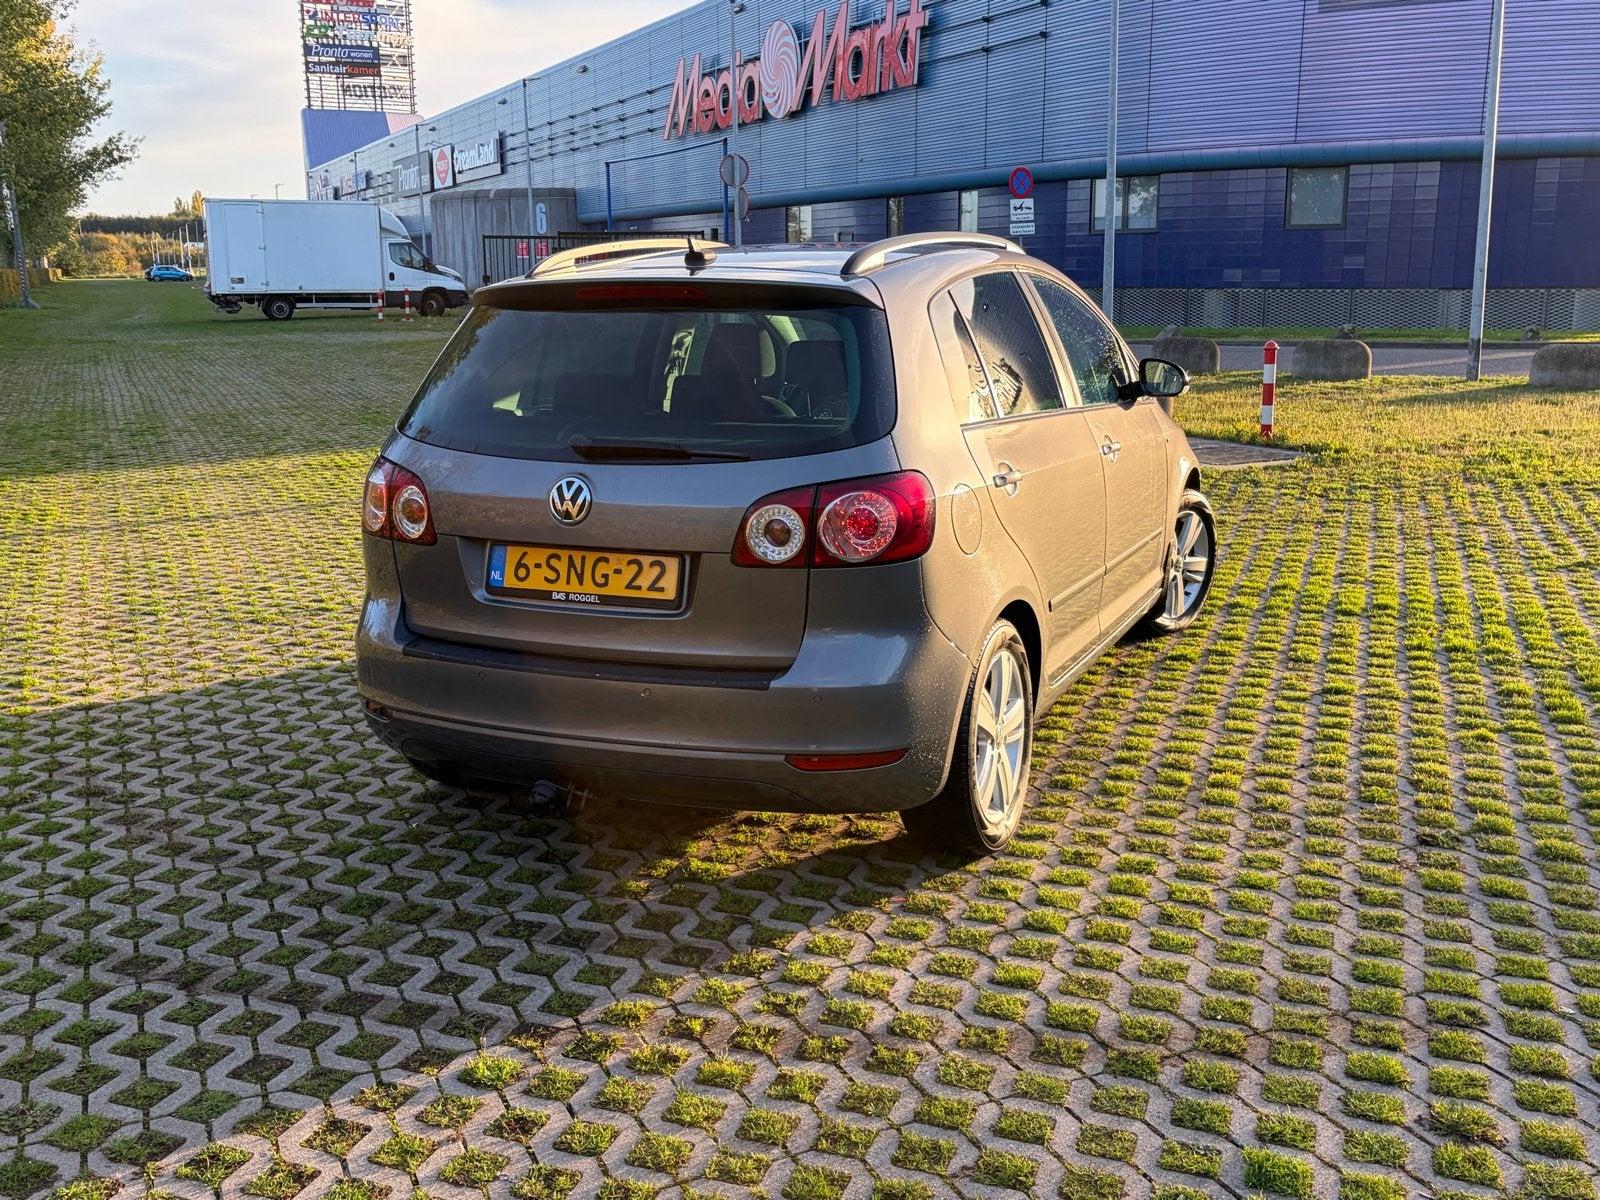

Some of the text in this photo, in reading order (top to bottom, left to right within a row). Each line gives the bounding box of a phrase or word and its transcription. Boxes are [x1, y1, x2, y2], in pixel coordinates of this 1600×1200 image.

[311, 44, 349, 58] Pronto
[308, 63, 379, 75] Sanitairkamer
[536, 202, 547, 234] 6
[491, 570, 502, 581] NL
[513, 551, 666, 592] 6-SNG-22
[569, 594, 600, 603] ROGGEL
